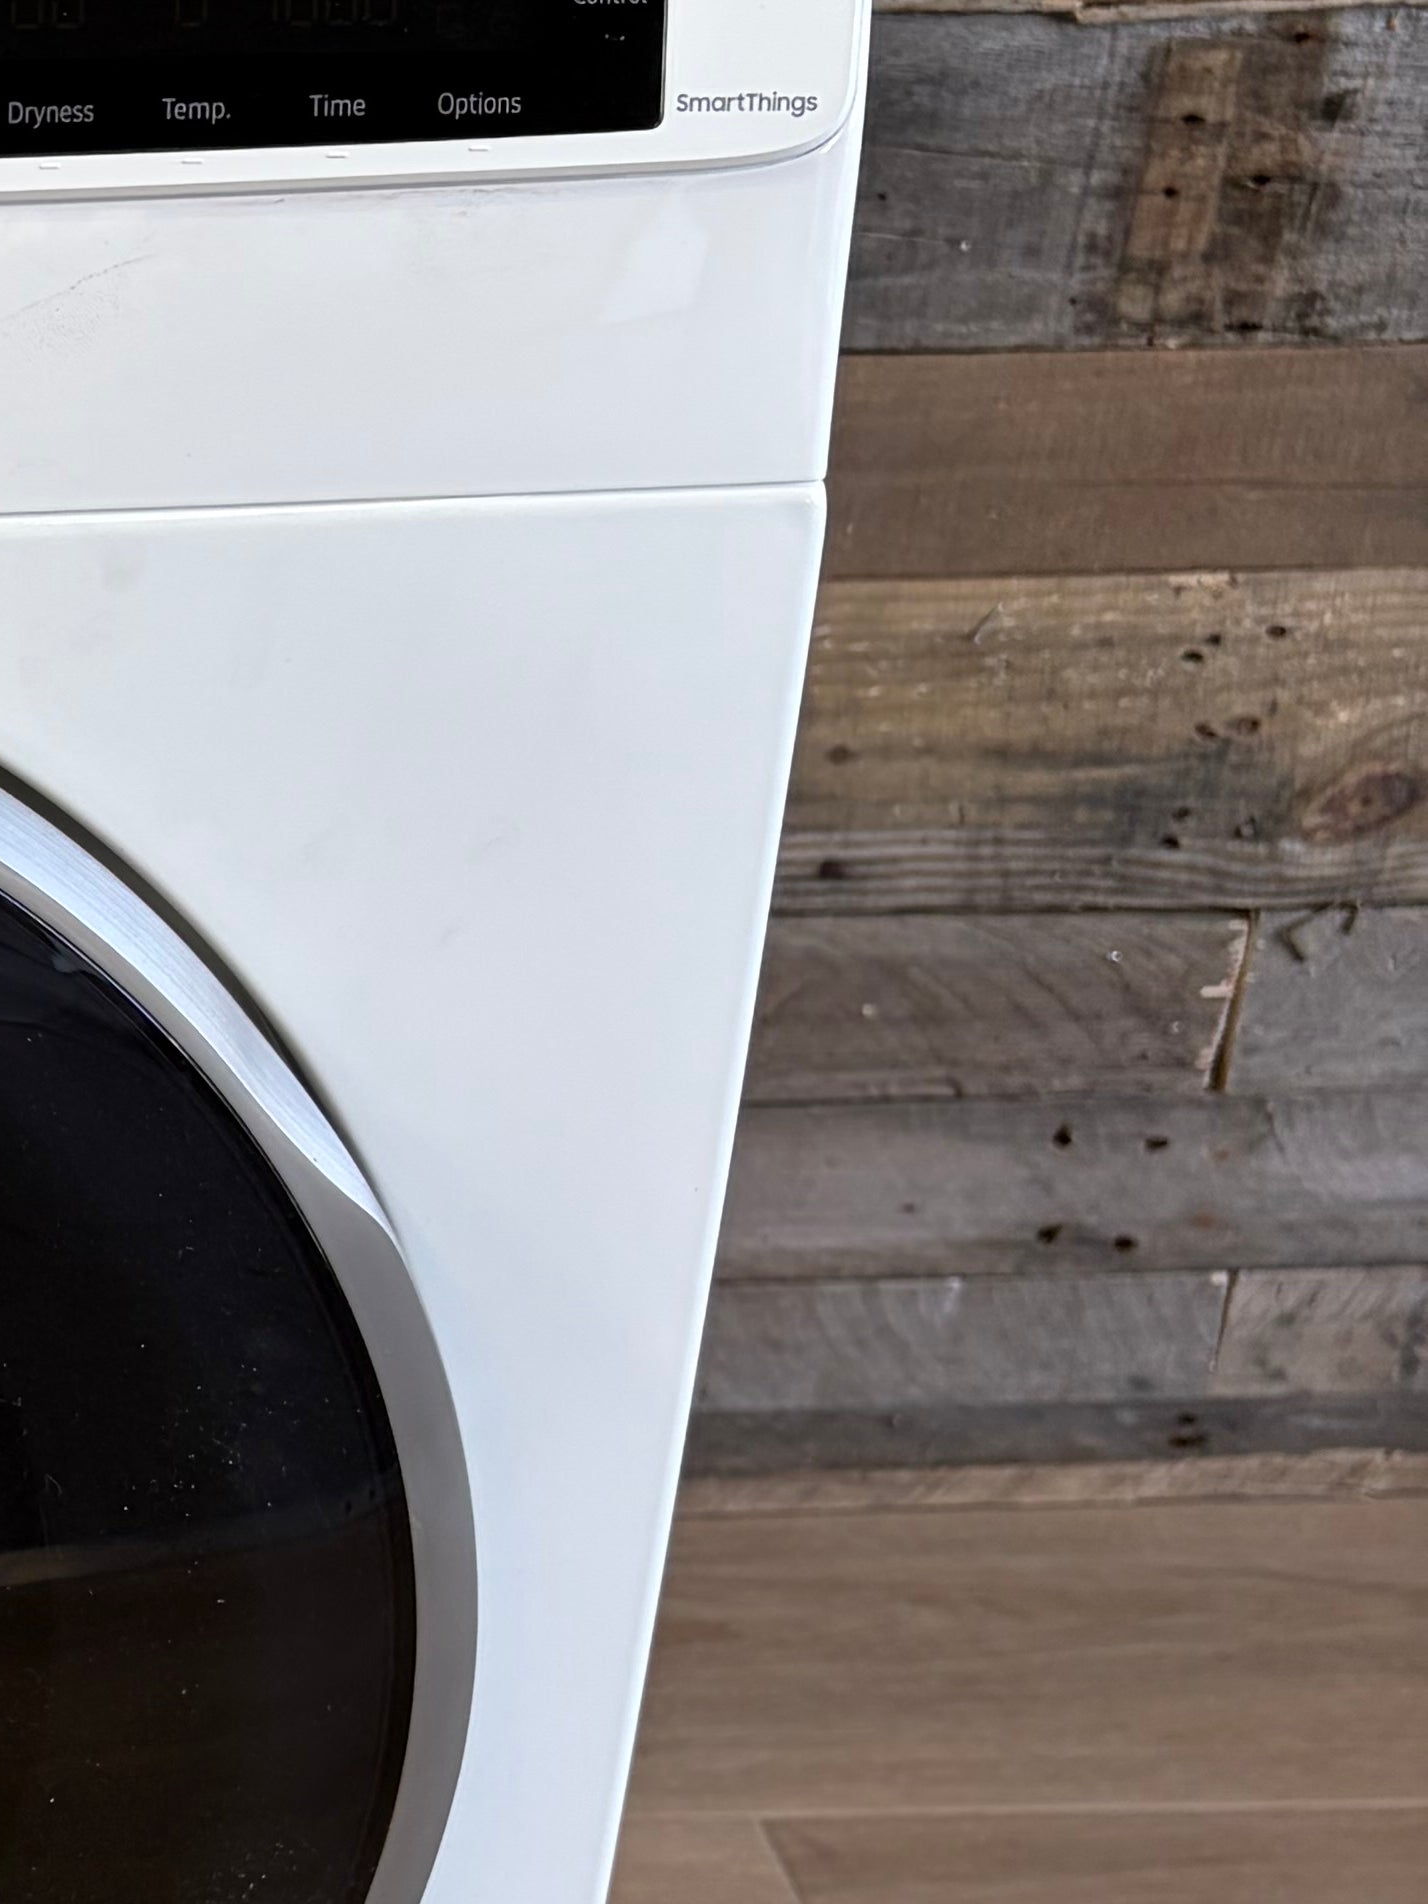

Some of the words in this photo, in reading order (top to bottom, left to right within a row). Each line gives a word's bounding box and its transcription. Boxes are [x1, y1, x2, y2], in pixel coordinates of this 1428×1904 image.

[7, 101, 94, 129] Dryness
[161, 97, 231, 125] Temp.
[308, 94, 366, 117] Time
[437, 91, 522, 120] Options
[676, 92, 818, 118] SmartThings
